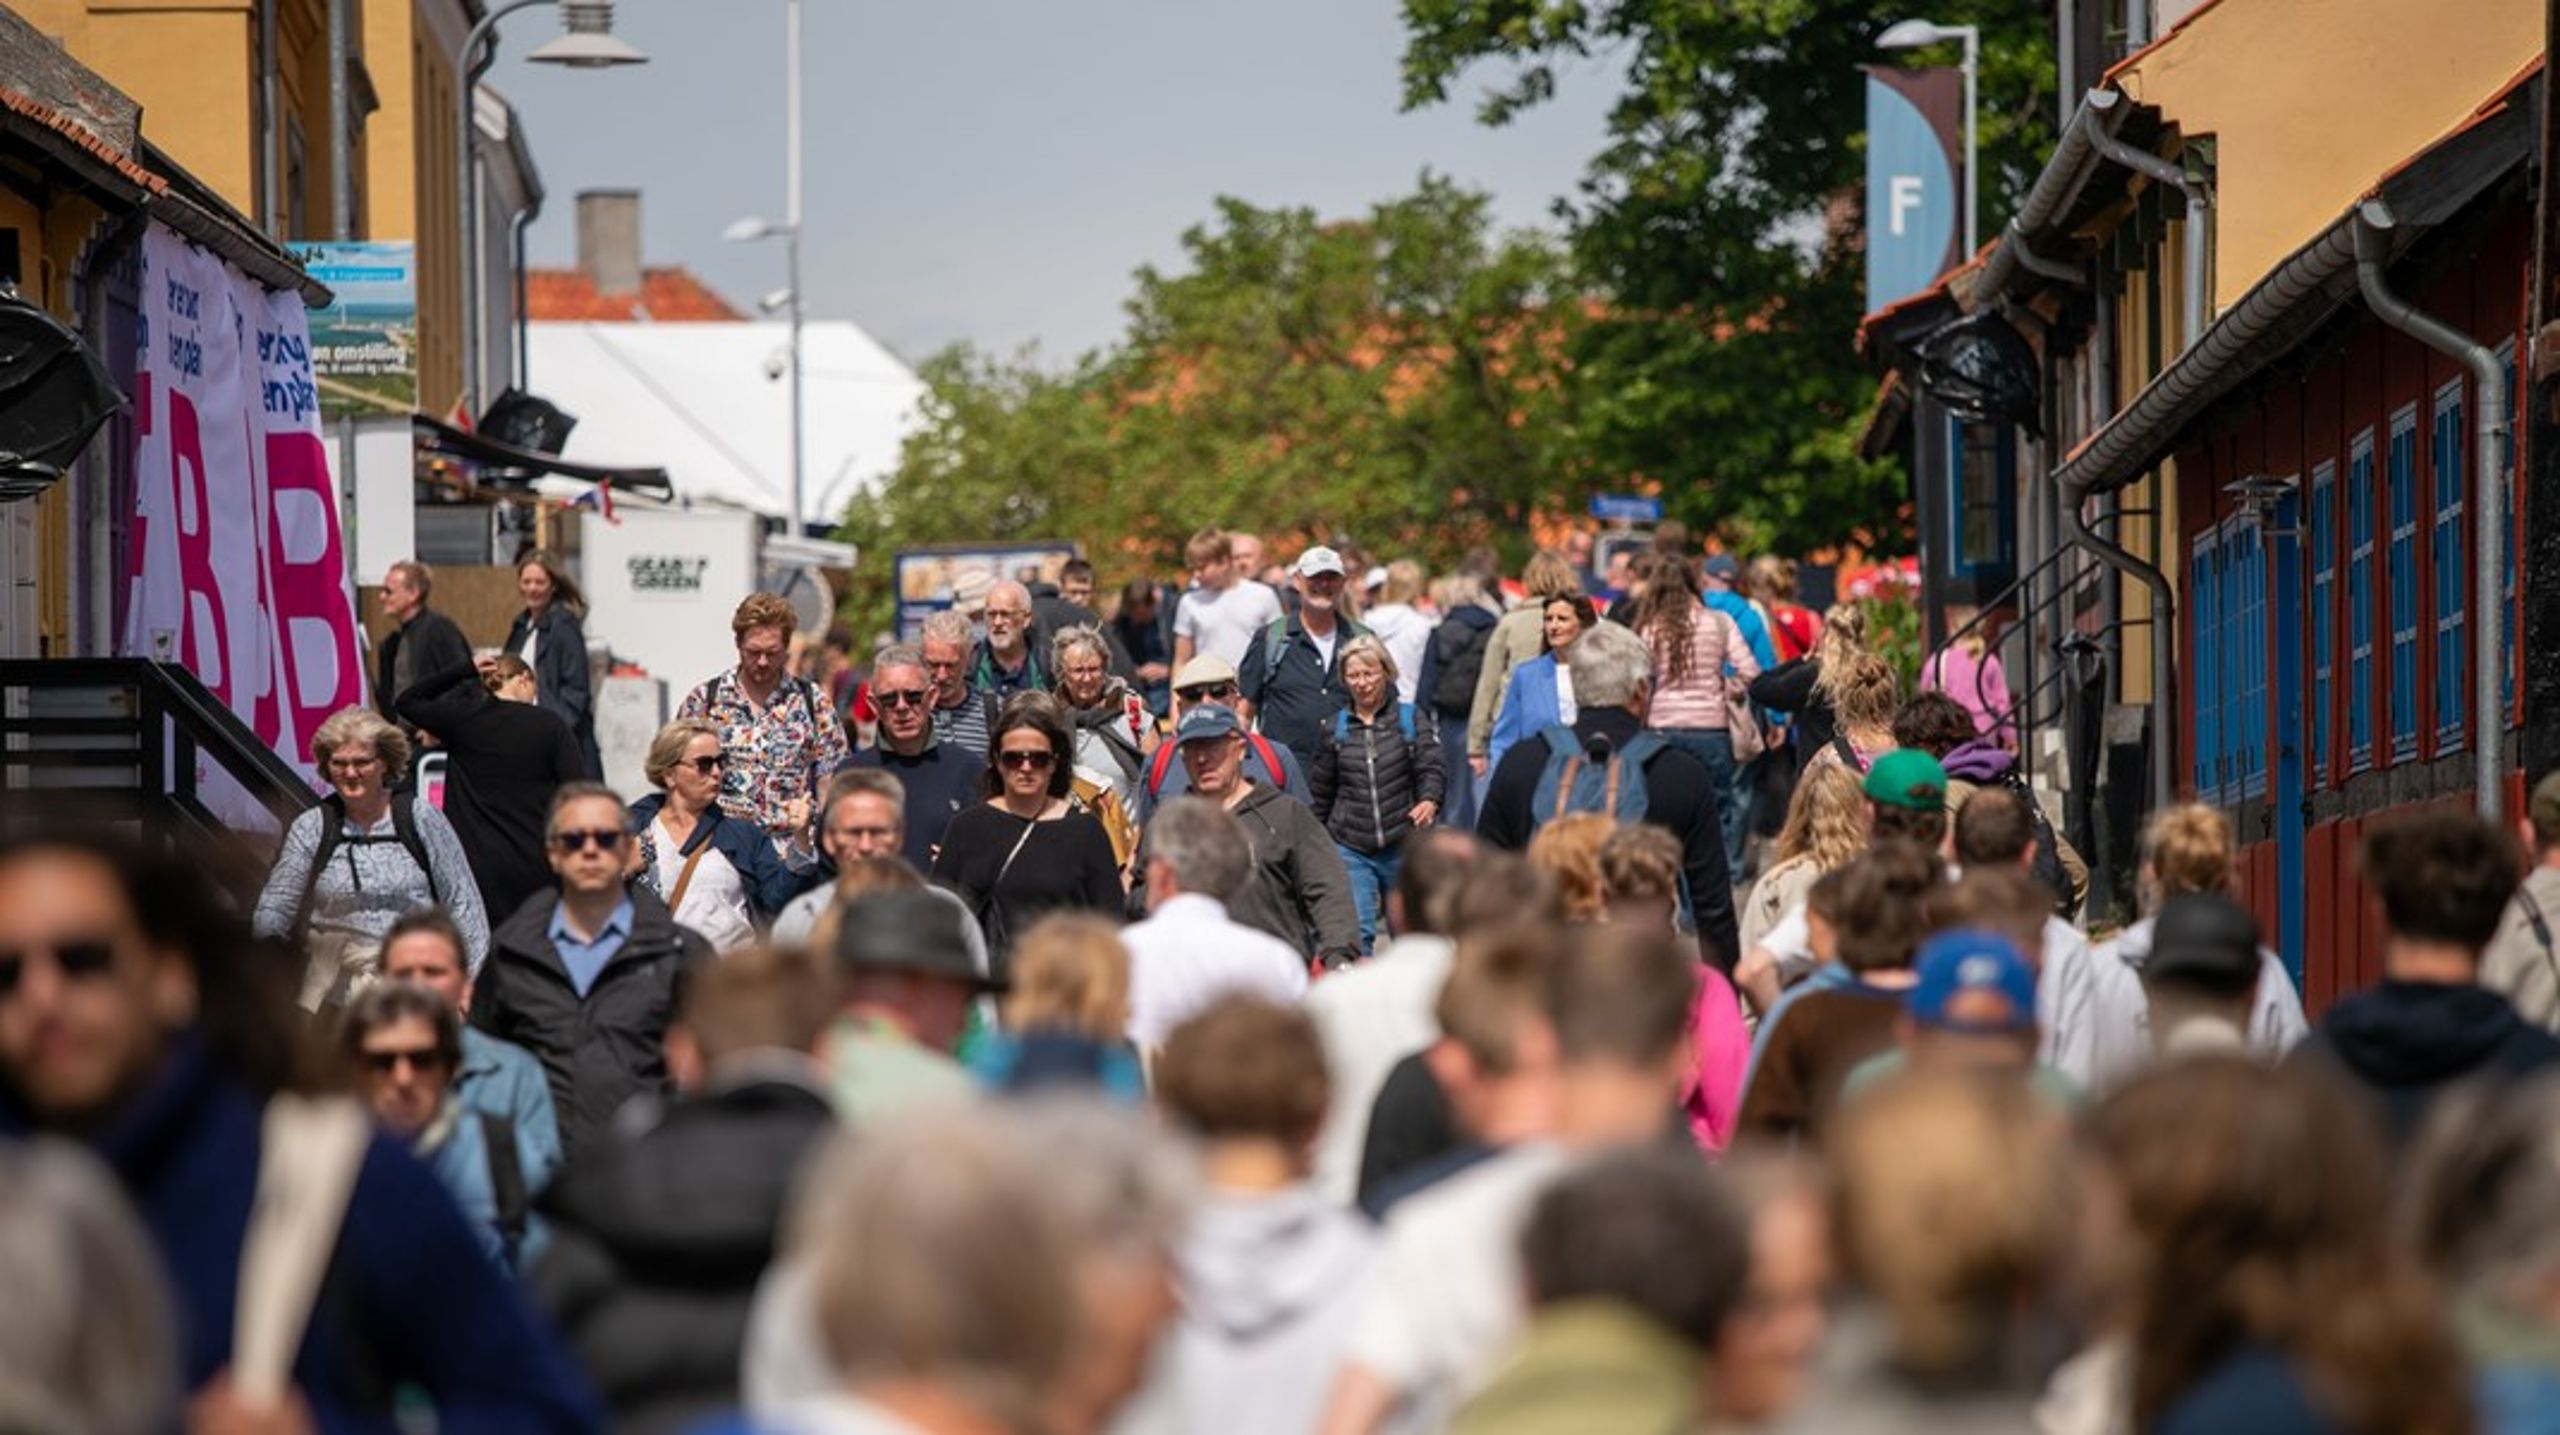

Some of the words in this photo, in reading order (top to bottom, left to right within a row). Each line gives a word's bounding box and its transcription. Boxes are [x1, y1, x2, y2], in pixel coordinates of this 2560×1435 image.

[1890, 177, 1923, 236] F
[334, 341, 406, 364] omstilling
[264, 431, 361, 763] B
